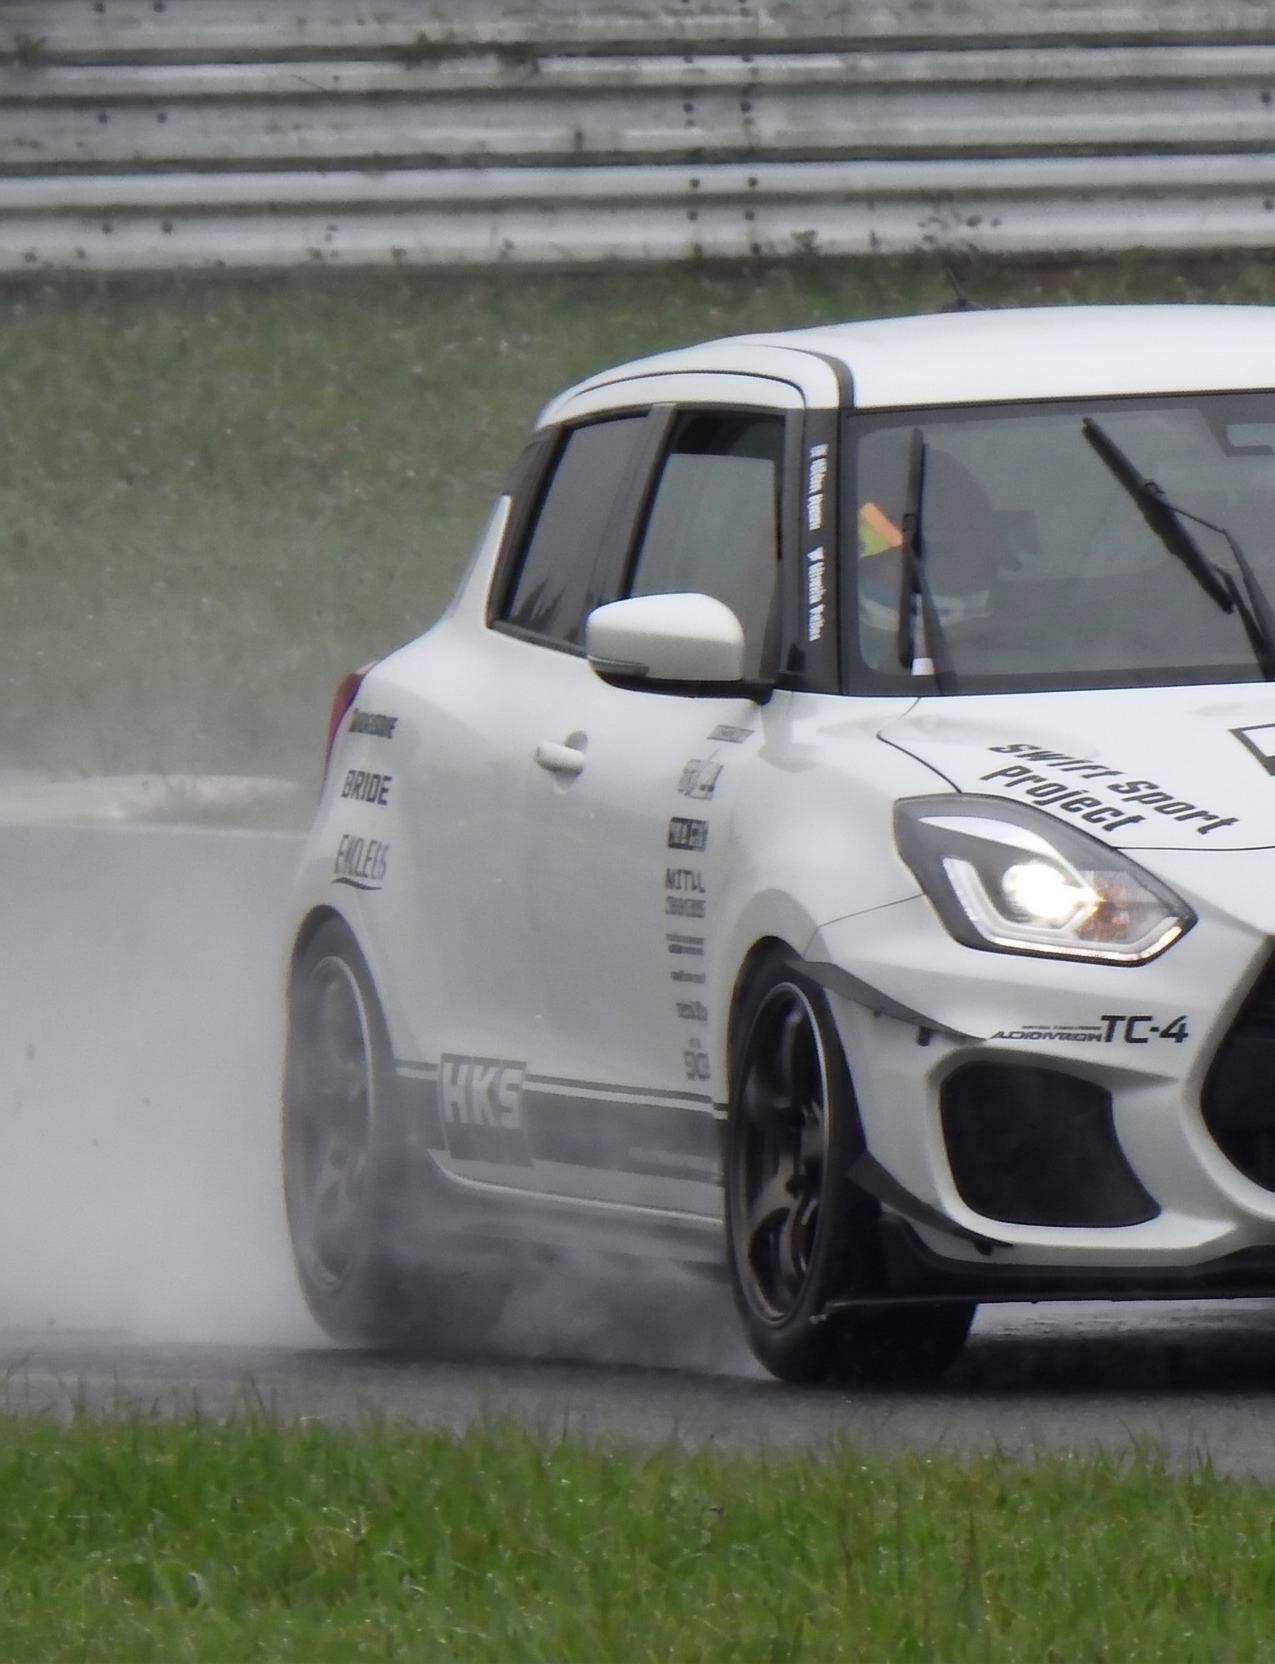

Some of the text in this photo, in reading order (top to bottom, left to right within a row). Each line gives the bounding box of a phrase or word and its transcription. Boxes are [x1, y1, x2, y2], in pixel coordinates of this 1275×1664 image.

[341, 769, 393, 806] BRIDE
[979, 765, 1147, 832] Project
[1101, 1014, 1189, 1044] TC-4
[442, 1060, 526, 1130] HKS
